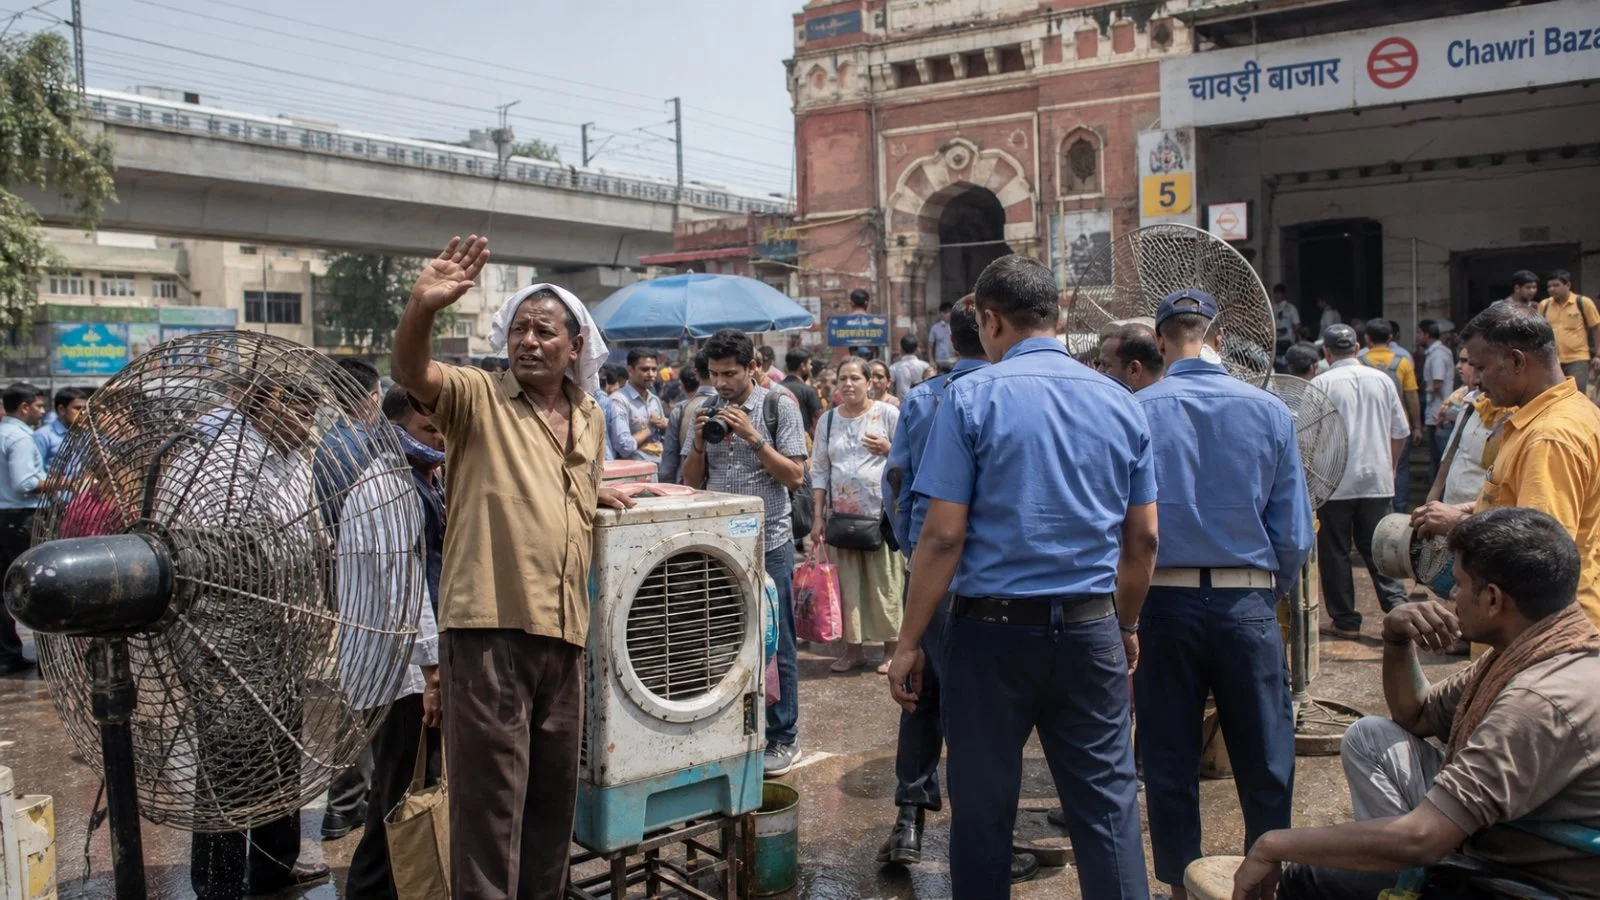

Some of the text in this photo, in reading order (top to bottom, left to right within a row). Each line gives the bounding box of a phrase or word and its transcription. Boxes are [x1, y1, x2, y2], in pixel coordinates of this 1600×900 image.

[1447, 30, 1535, 68] Chawri
[1188, 58, 1341, 103] चावड़ी बाजार
[1159, 181, 1176, 208] 5
